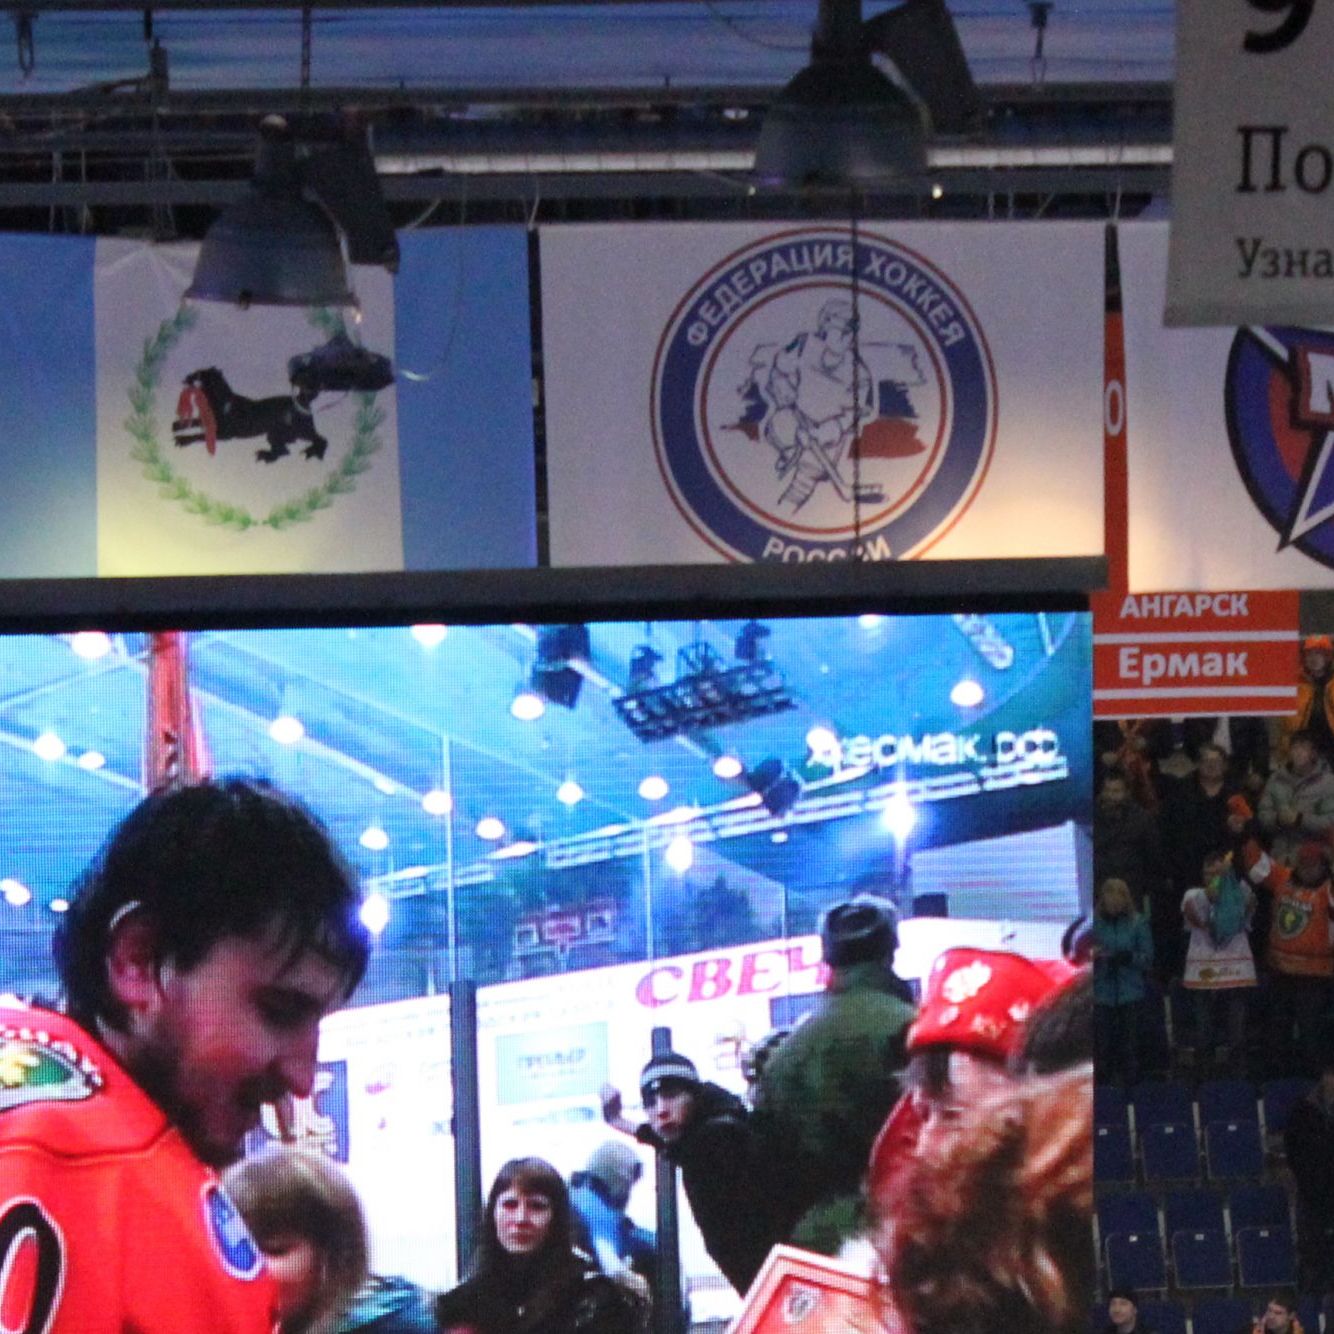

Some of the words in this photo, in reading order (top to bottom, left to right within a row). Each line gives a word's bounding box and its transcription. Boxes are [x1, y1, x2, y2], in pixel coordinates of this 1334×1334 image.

[686, 245, 855, 348] ФЕДЕРАЦИЯ
[866, 254, 967, 348] ХОККЕЯ
[762, 535, 892, 562] РОССИ
[1119, 594, 1249, 619] АНГАРСК
[1118, 647, 1249, 685] Ермак
